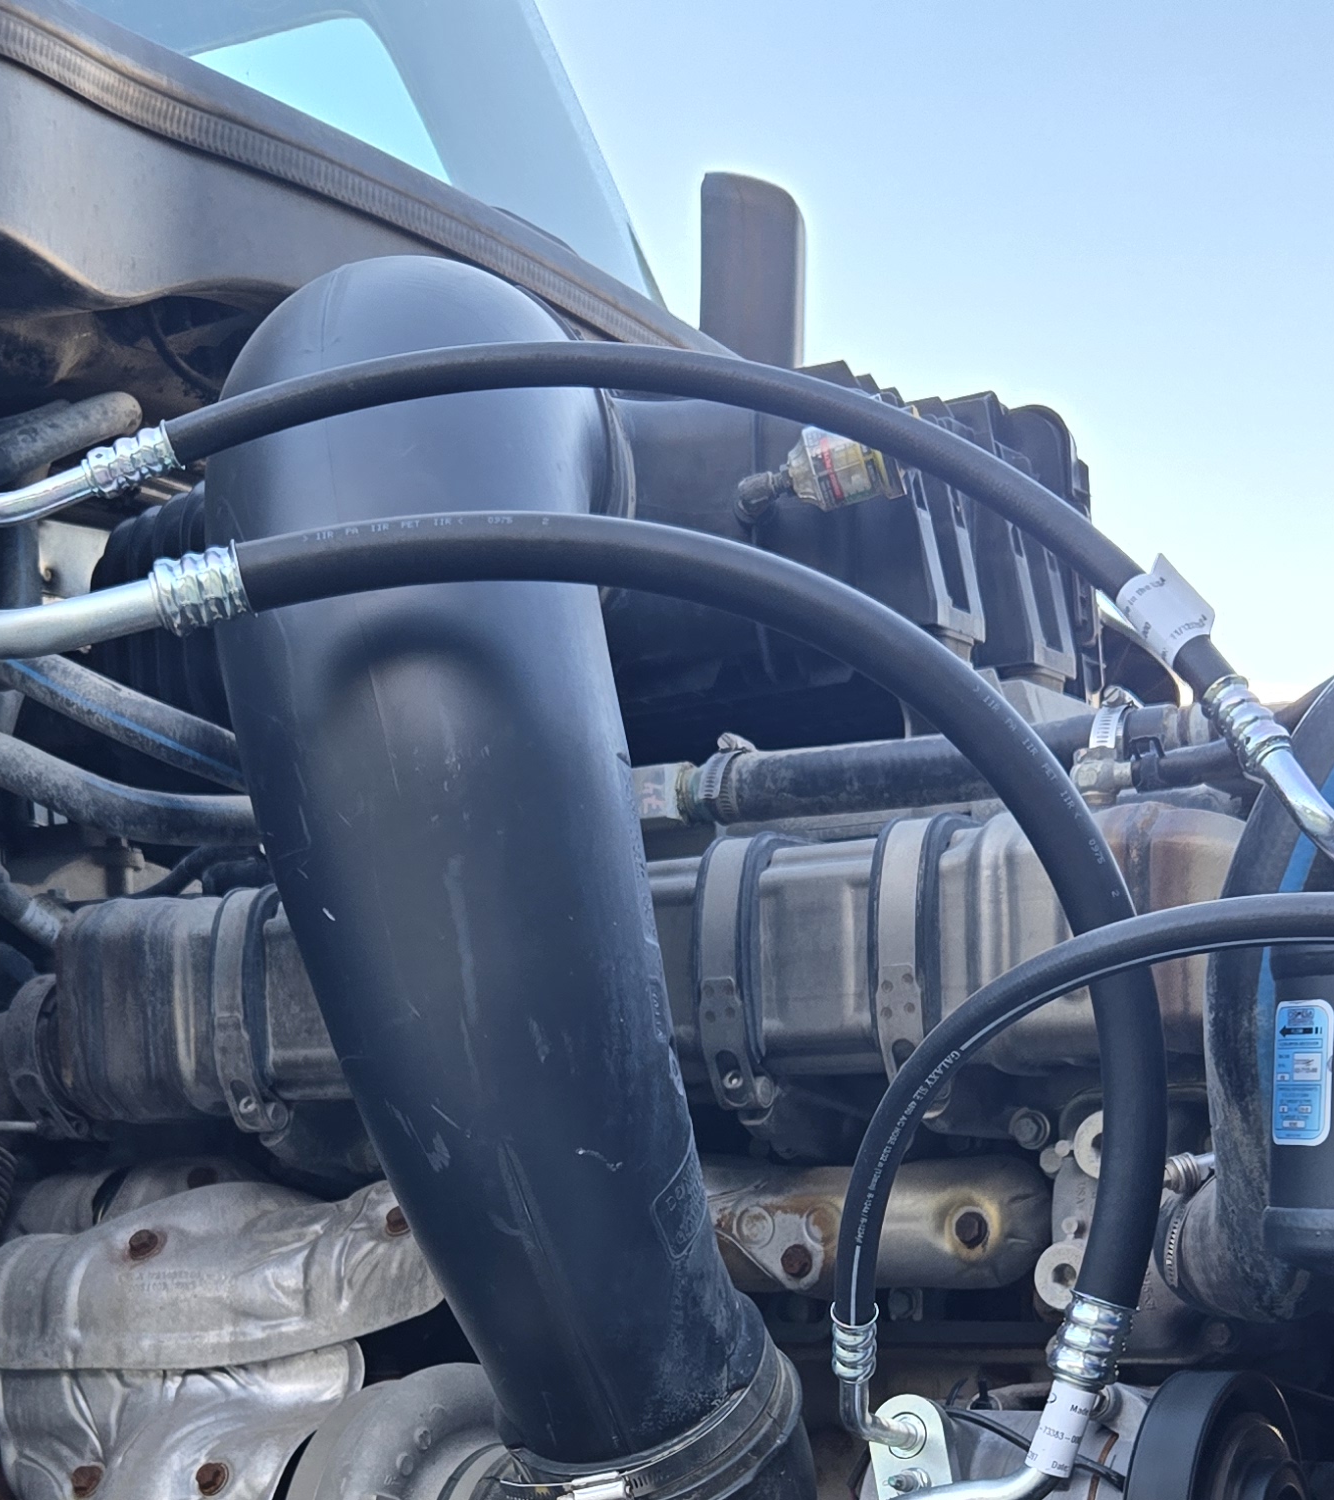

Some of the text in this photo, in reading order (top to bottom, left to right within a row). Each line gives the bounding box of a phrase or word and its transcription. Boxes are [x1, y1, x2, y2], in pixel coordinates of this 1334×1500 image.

[924, 1051, 961, 1087] GALAXY
[913, 1085, 929, 1100] SLE
[887, 1126, 902, 1145] HOSE
